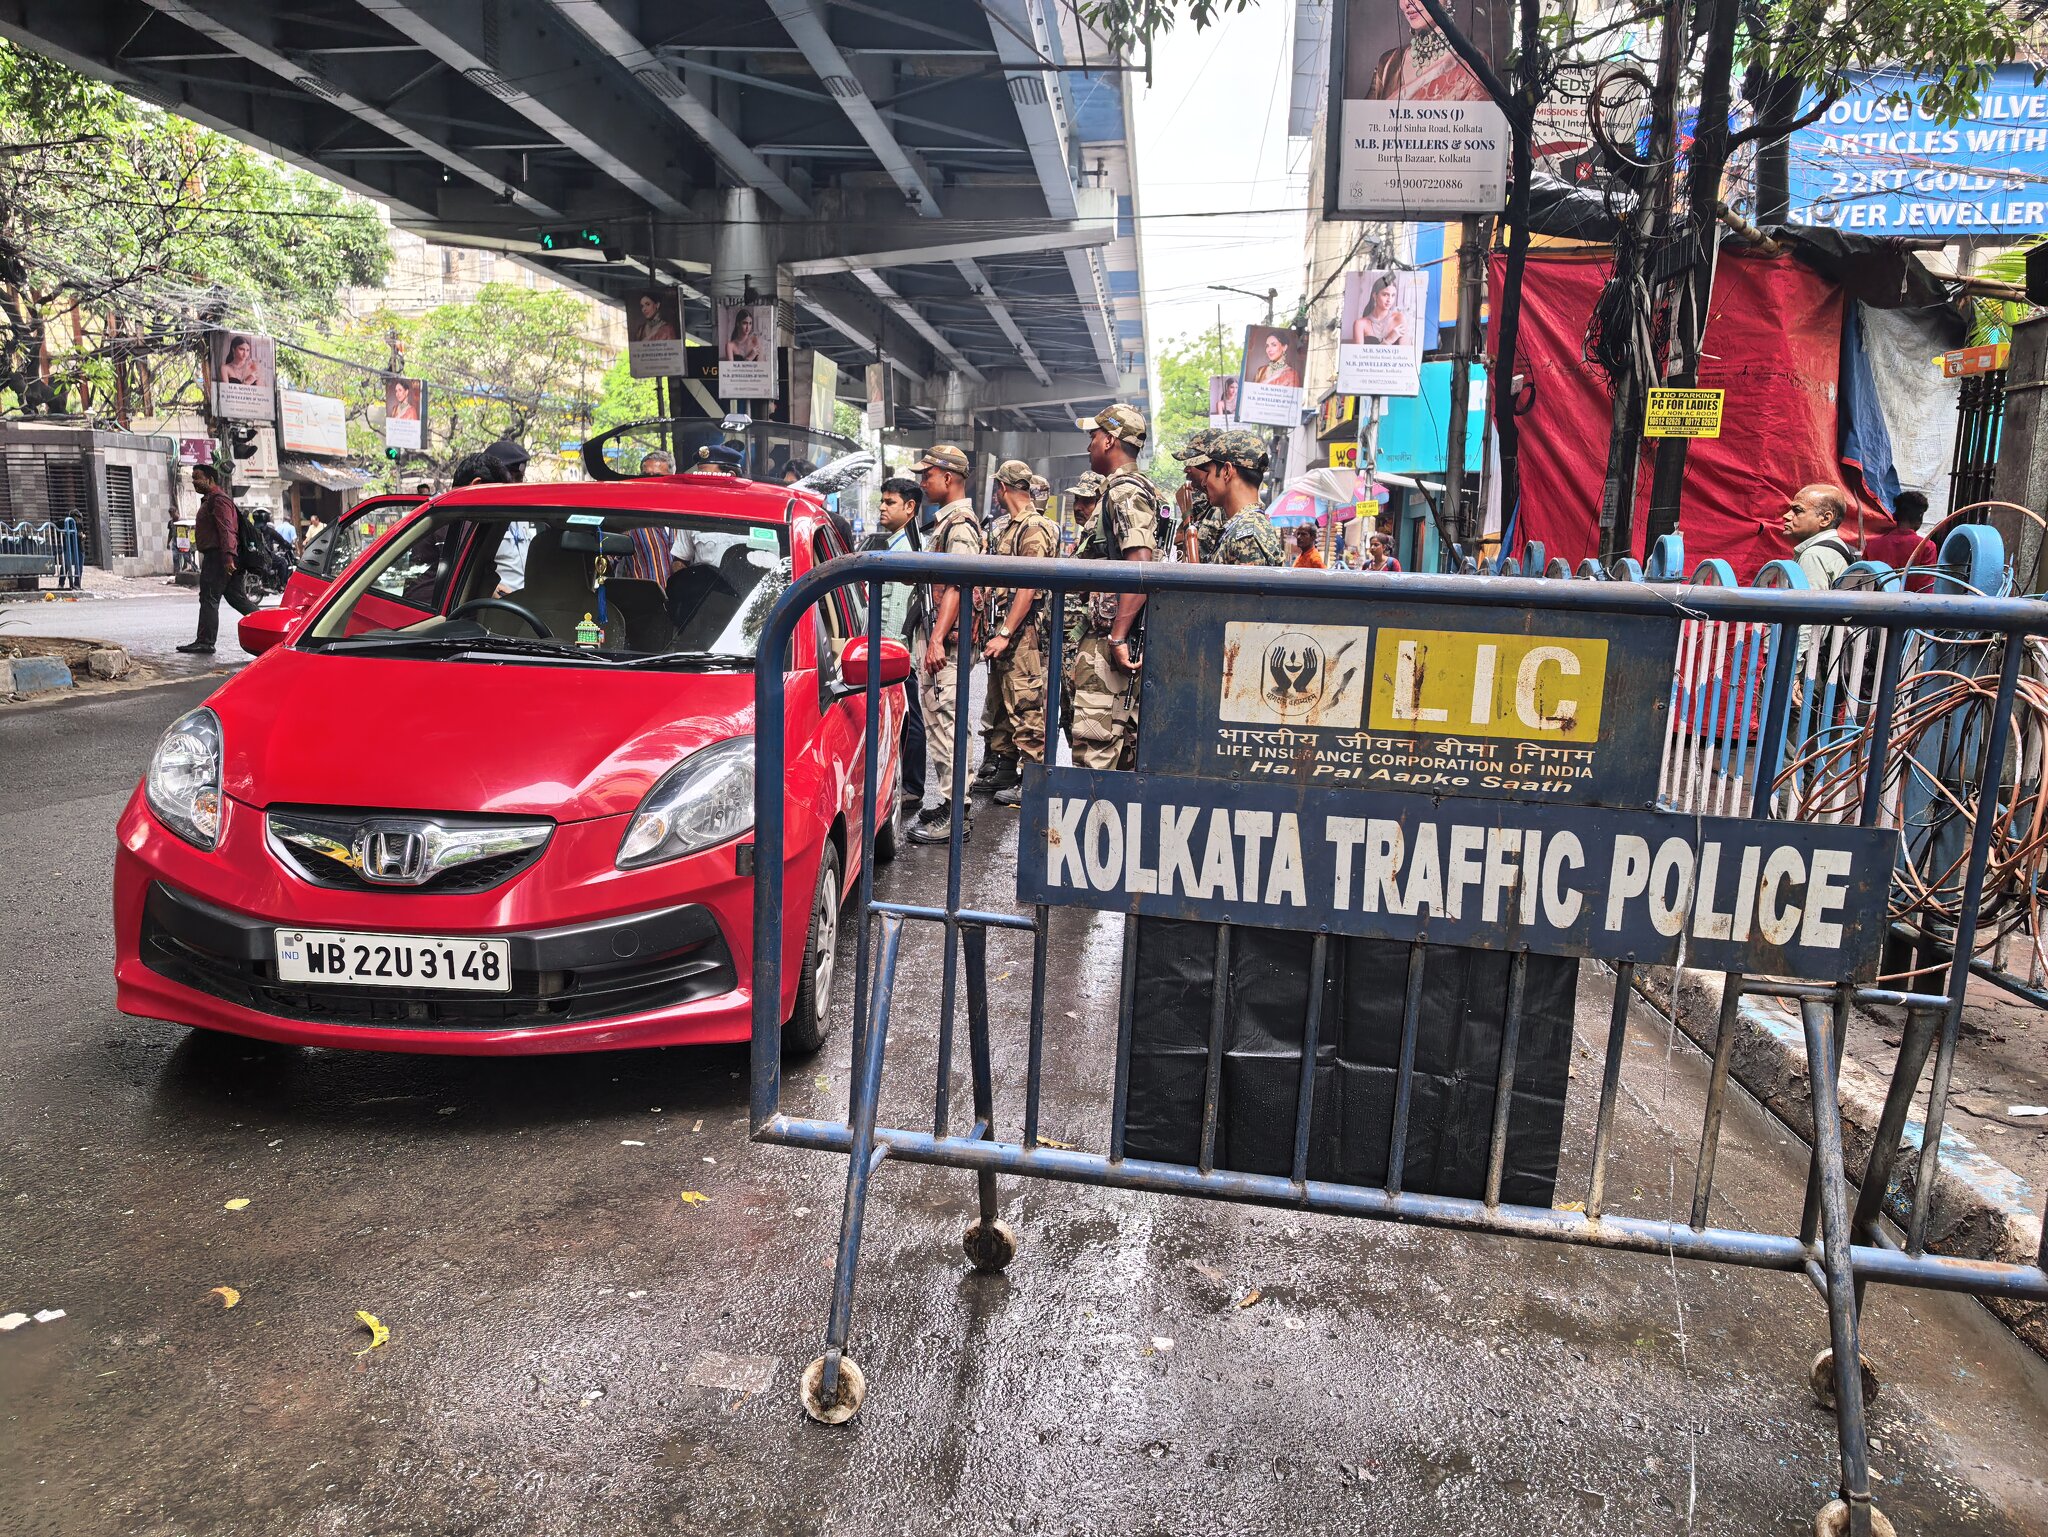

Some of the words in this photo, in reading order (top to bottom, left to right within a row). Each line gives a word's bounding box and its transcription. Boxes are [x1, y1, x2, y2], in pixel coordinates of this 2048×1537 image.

[1389, 108, 1414, 120] M.B.
[1416, 109, 1448, 120] SONS
[1450, 109, 1464, 122] (J)
[1536, 108, 1578, 117] MISSIONS
[1369, 124, 1381, 134] 7B,
[1383, 123, 1402, 133] Lord
[1404, 124, 1426, 133] Sinha
[1428, 124, 1450, 134] Road,
[1453, 124, 1483, 133] Kolkata
[1354, 139, 1379, 150] M.B.
[1382, 139, 1449, 151] JEWELLERS
[1451, 139, 1462, 150] &
[1464, 139, 1496, 150] SONS
[1817, 130, 1959, 157] ARTICLES
[1965, 128, 2048, 152] WITH
[1378, 154, 1402, 163] Burra
[1405, 154, 1436, 165] Bazaar,
[1439, 154, 1471, 163] Kolkata
[1403, 179, 1463, 189] 9007220886
[1831, 169, 1910, 194] 22KT
[1914, 168, 1998, 192] GOLD
[2002, 167, 2027, 191] &
[1787, 202, 1888, 226] SILVER
[1892, 201, 2048, 226] JEWELLER
[1652, 399, 1664, 409] PG
[1666, 400, 1683, 410] FOR
[1686, 400, 1718, 411] LADIES
[1392, 640, 1580, 730] LIC
[1218, 728, 1320, 747] भारतीय
[1336, 732, 1417, 753] जीवन
[1433, 737, 1498, 758] बीमा
[1515, 742, 1596, 764] निगम
[1216, 744, 1253, 757] LIFE
[1369, 753, 1503, 773] CORPORATION
[1509, 763, 1535, 775] OF
[1541, 765, 1593, 778] INDIA
[1312, 764, 1363, 779] Pal
[1368, 771, 1470, 786] Aapke
[1480, 776, 1573, 793] Saath
[1046, 797, 1306, 908] KOLKATA
[1326, 815, 1584, 930] TRAFFIC
[1606, 833, 1851, 949] POLICE
[282, 951, 299, 960] IND
